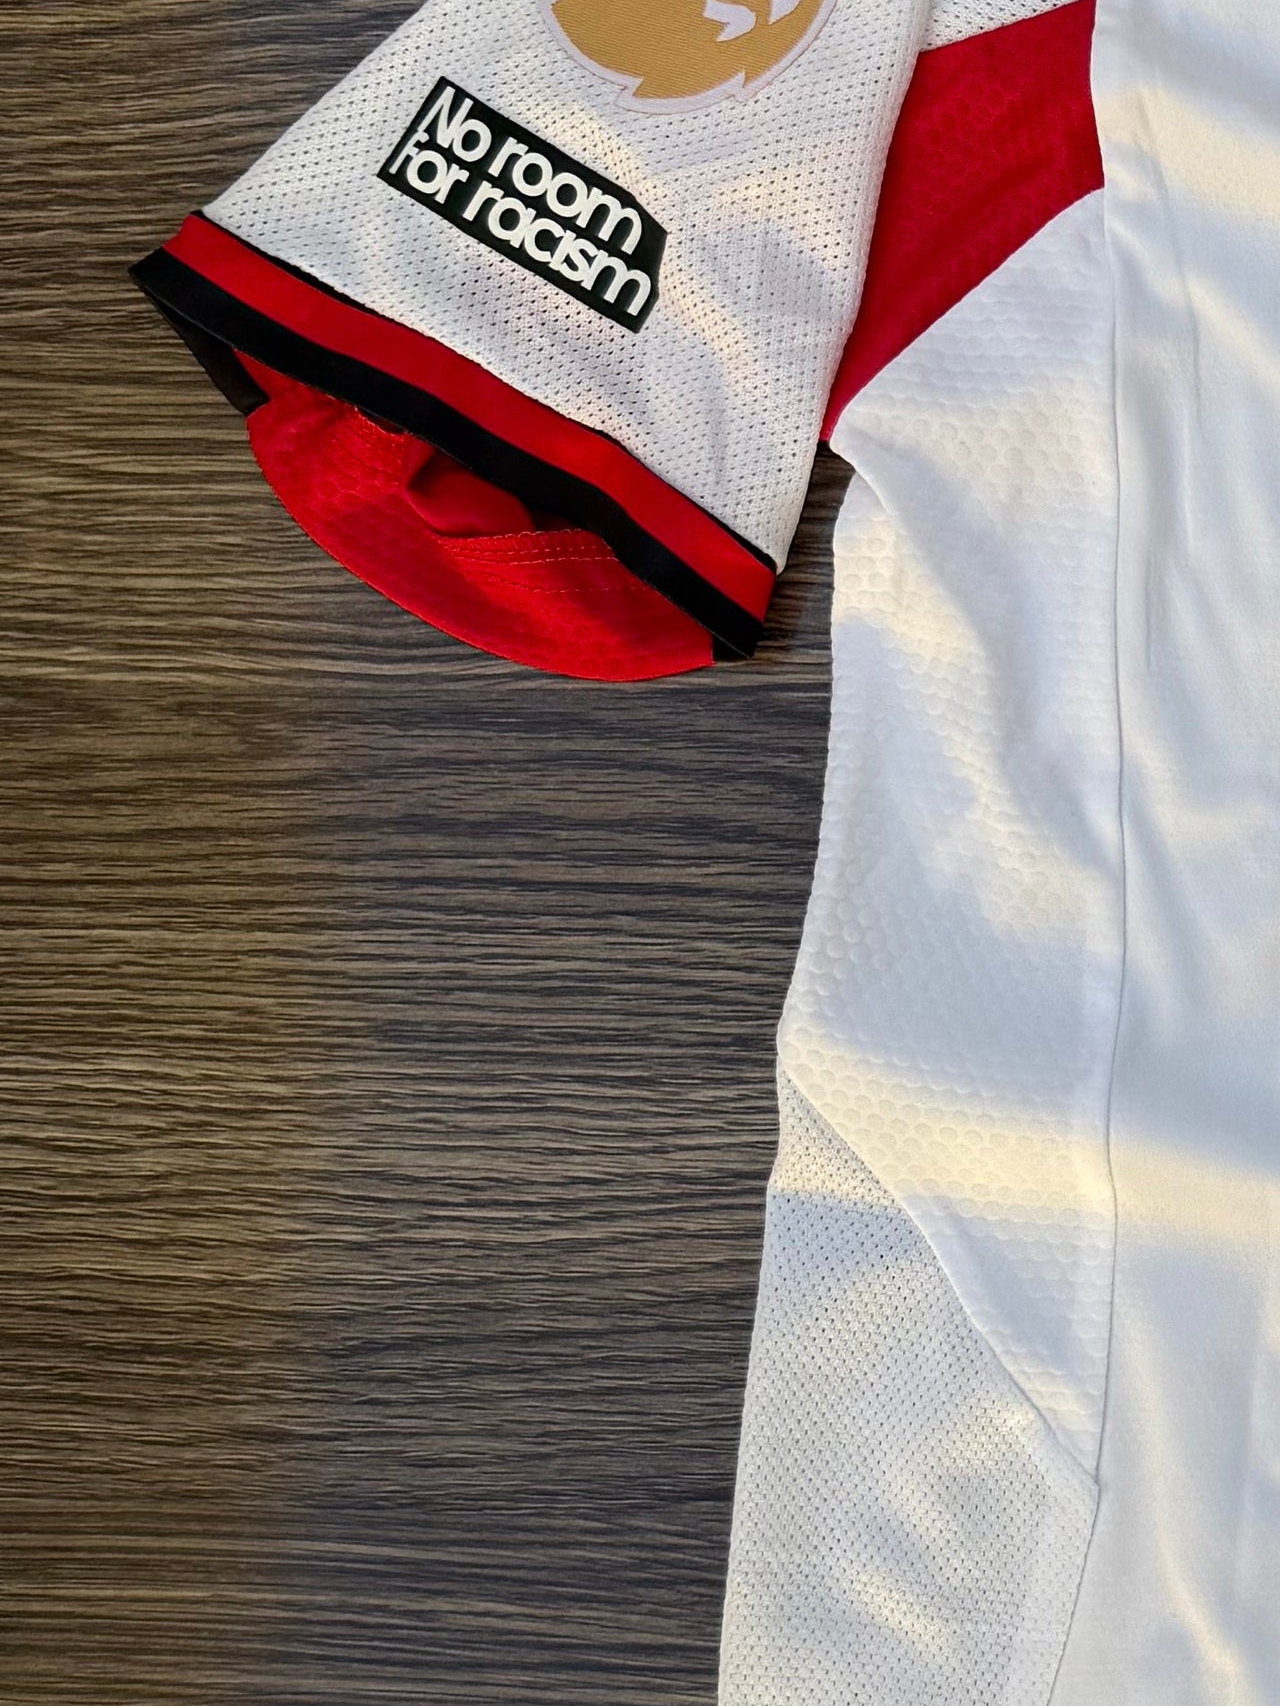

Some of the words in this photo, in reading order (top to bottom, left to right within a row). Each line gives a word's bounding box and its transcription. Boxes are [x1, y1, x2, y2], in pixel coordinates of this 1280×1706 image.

[417, 86, 492, 163] No
[488, 136, 643, 255] room
[462, 180, 652, 316] racism
